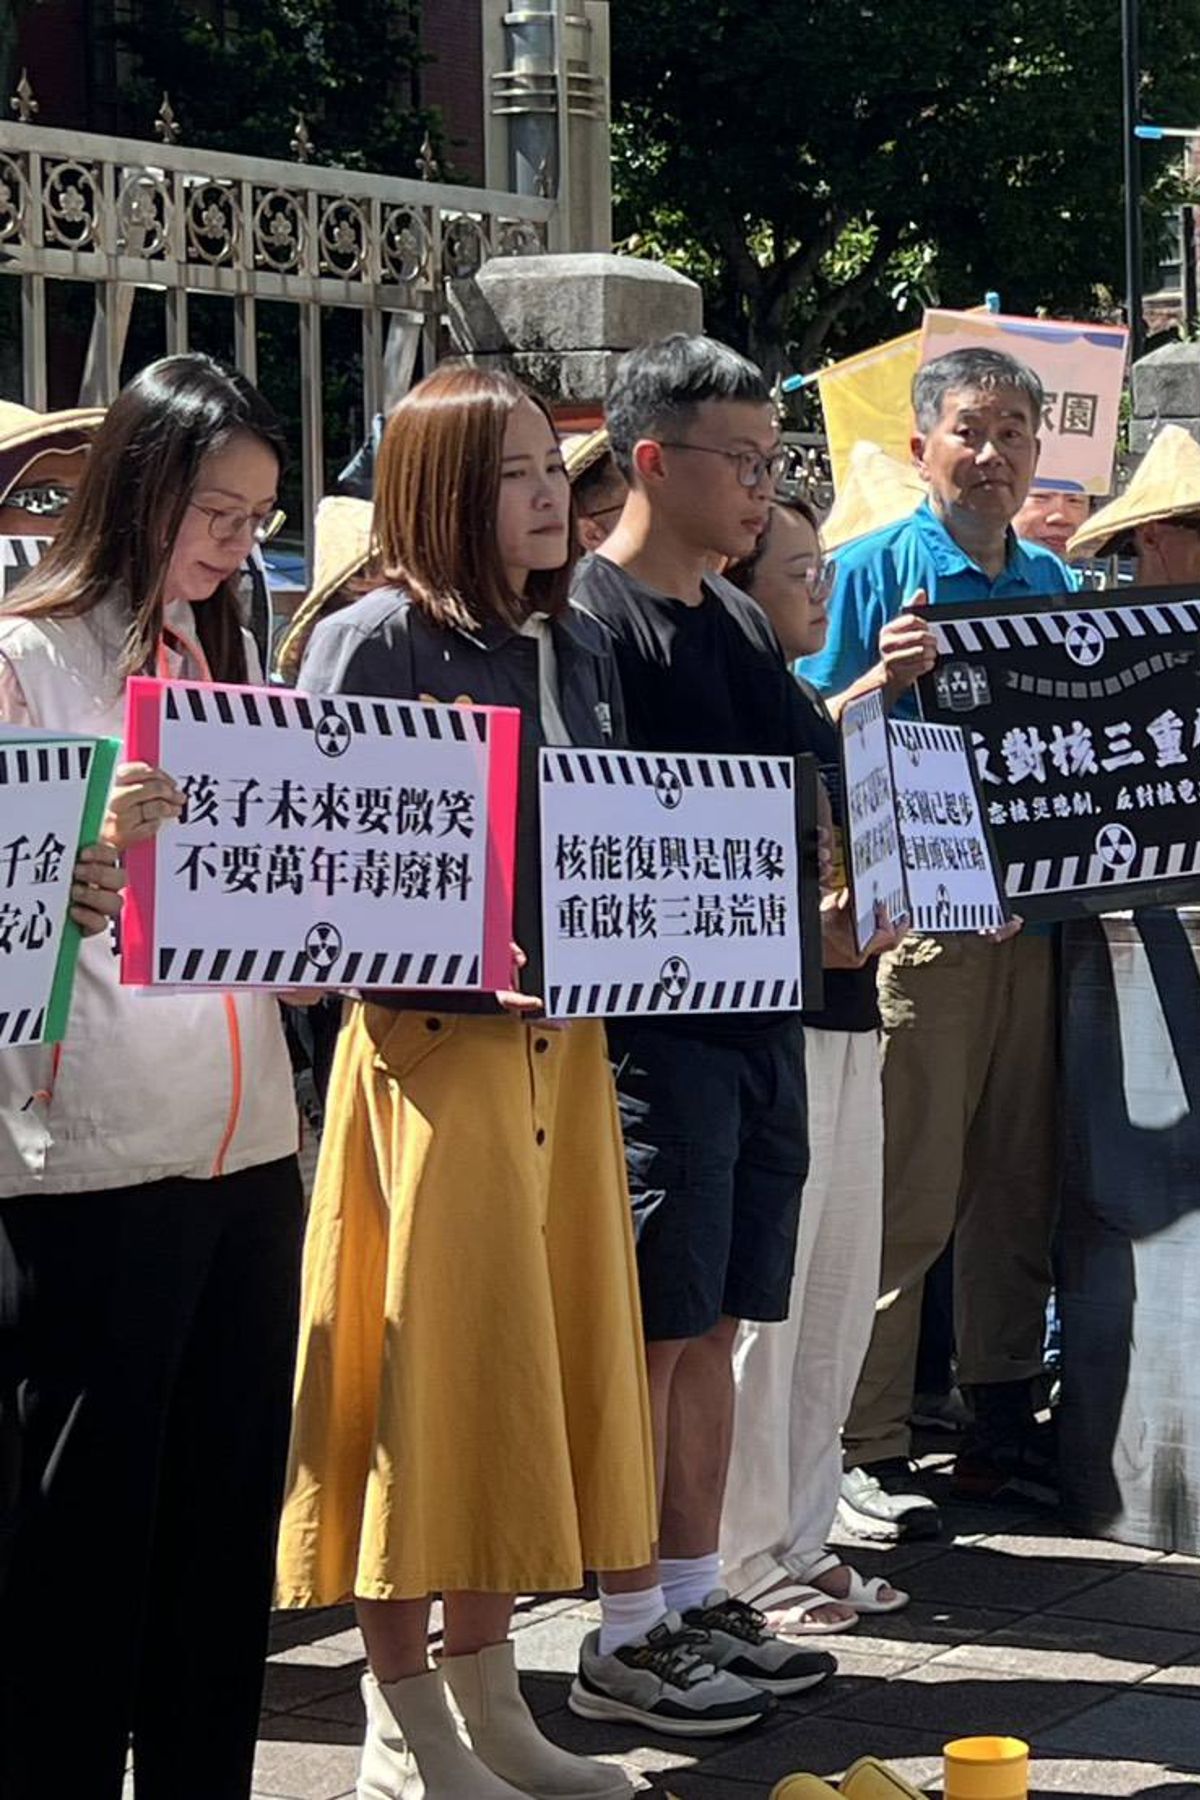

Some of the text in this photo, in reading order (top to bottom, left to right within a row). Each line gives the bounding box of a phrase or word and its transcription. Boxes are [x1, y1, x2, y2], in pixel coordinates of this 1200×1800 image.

[177, 774, 475, 839] 孩子未來要微笑
[2, 832, 66, 888] 千金
[174, 842, 474, 901] 不要萬年毒廢料
[555, 833, 786, 882] 核能復興是假象
[555, 893, 788, 940] 重啟核三最荒唐
